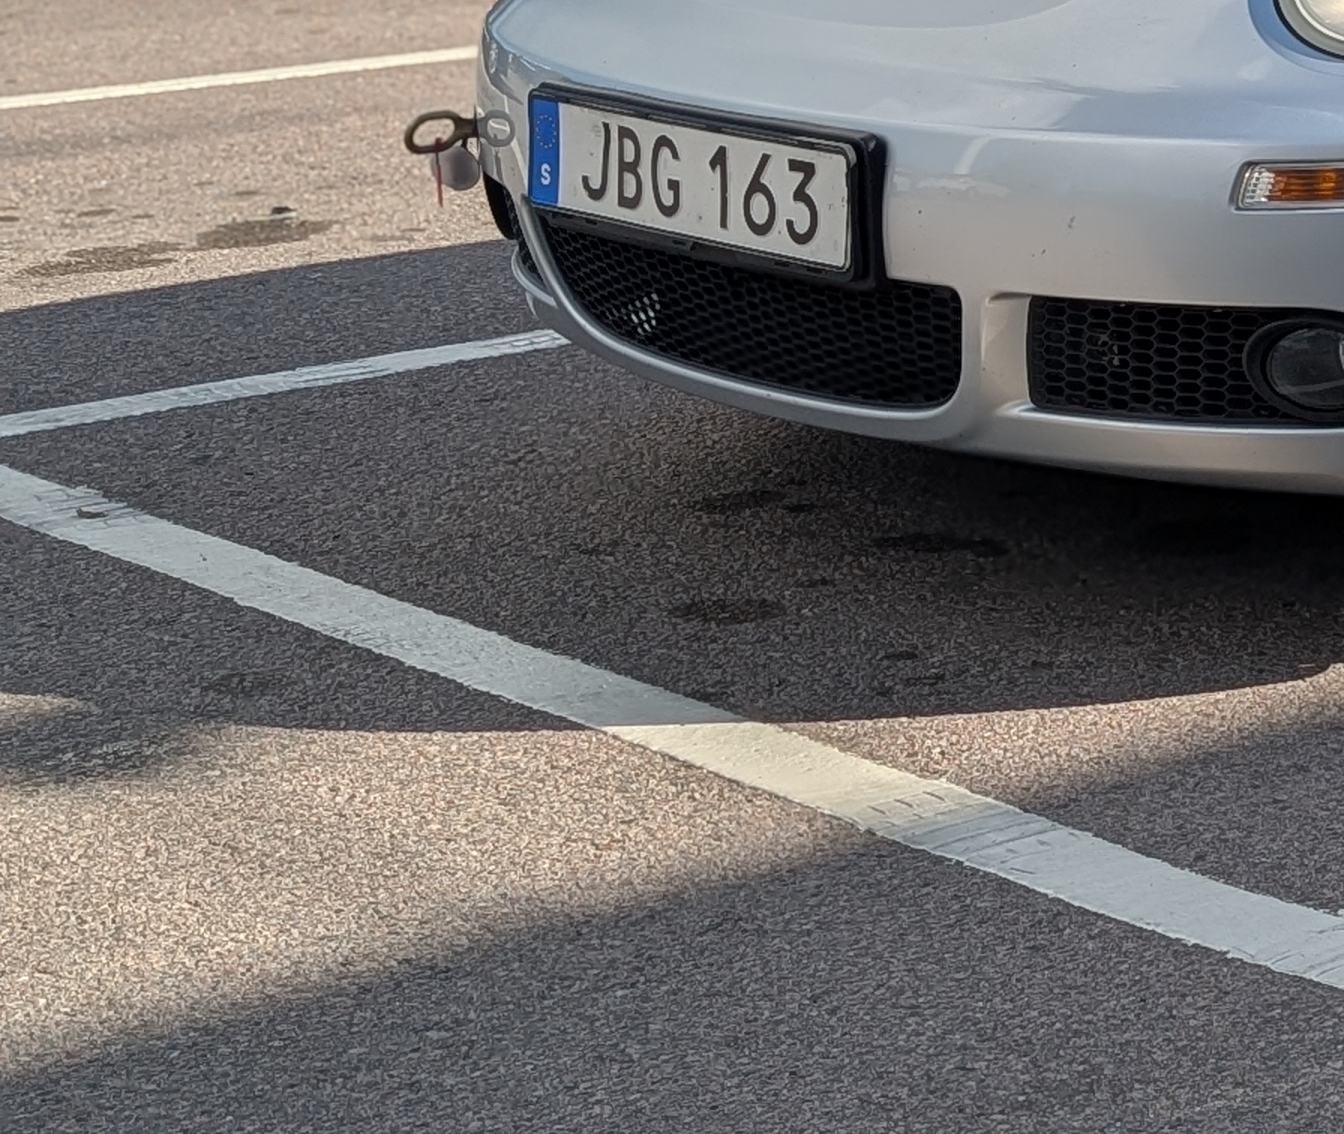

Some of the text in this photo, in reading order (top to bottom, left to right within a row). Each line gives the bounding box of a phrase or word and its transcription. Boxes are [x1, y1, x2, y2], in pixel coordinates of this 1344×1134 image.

[540, 163, 552, 186] S
[581, 122, 819, 246] JBG 163
